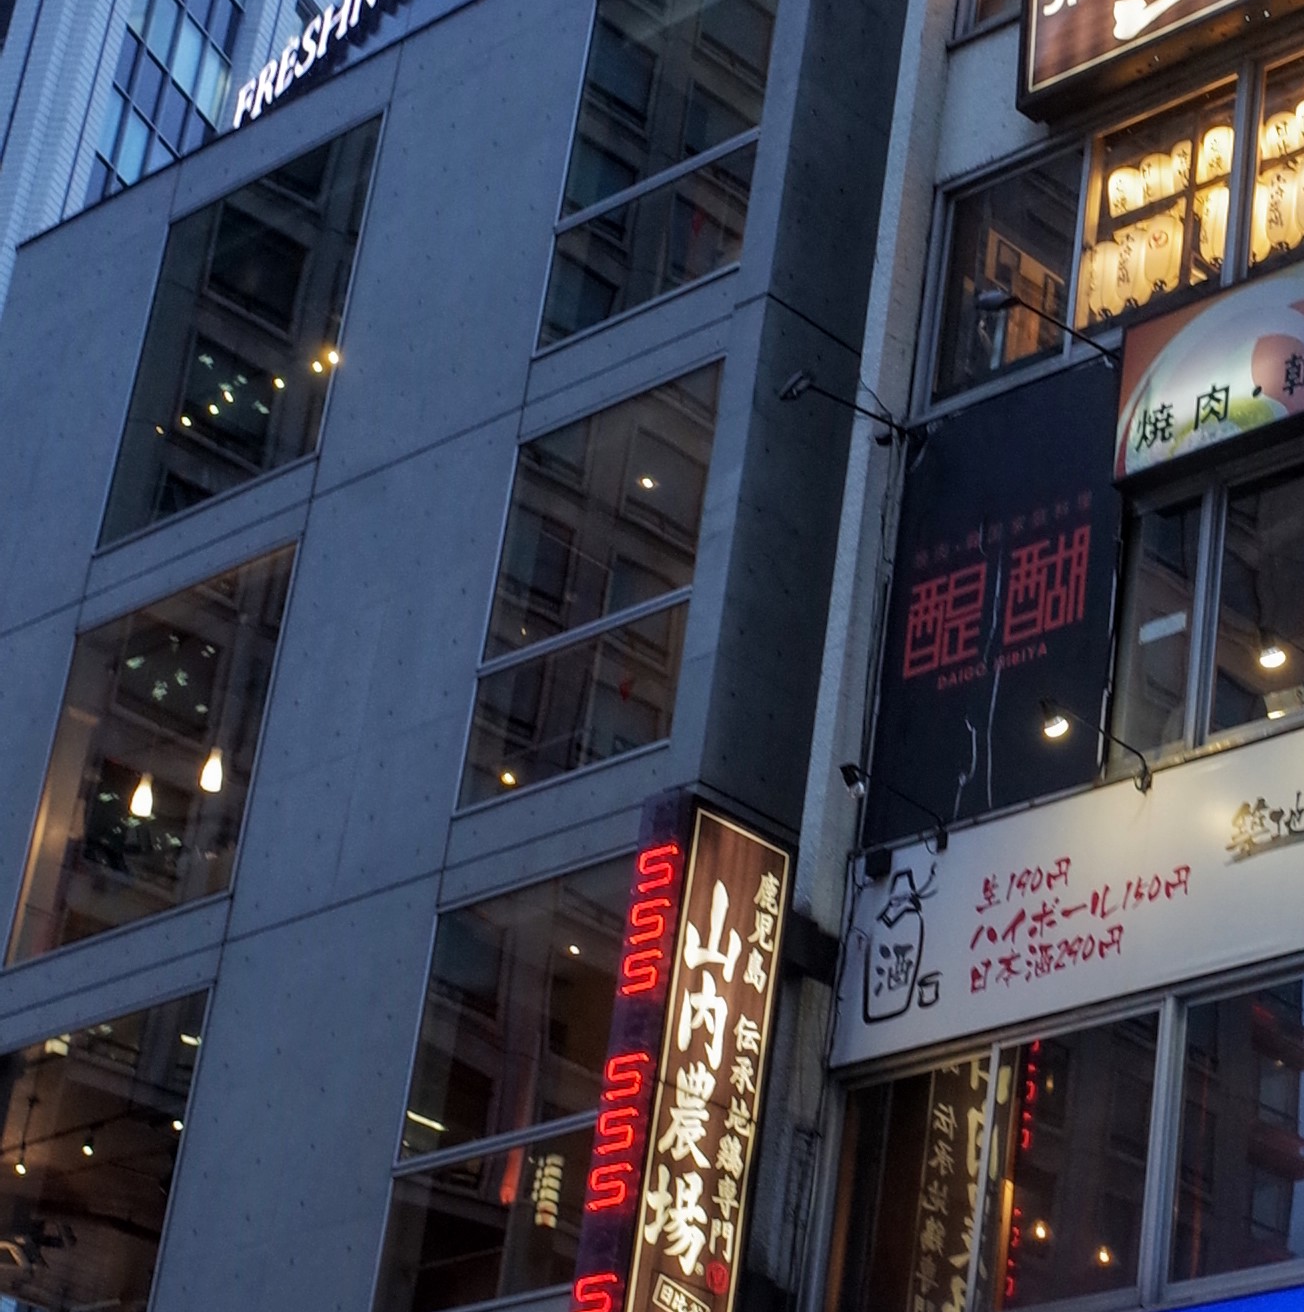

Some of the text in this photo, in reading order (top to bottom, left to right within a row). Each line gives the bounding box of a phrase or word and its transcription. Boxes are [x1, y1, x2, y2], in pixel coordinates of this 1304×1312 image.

[643, 879, 742, 1276] 山内農場
[875, 942, 915, 997] 酒
